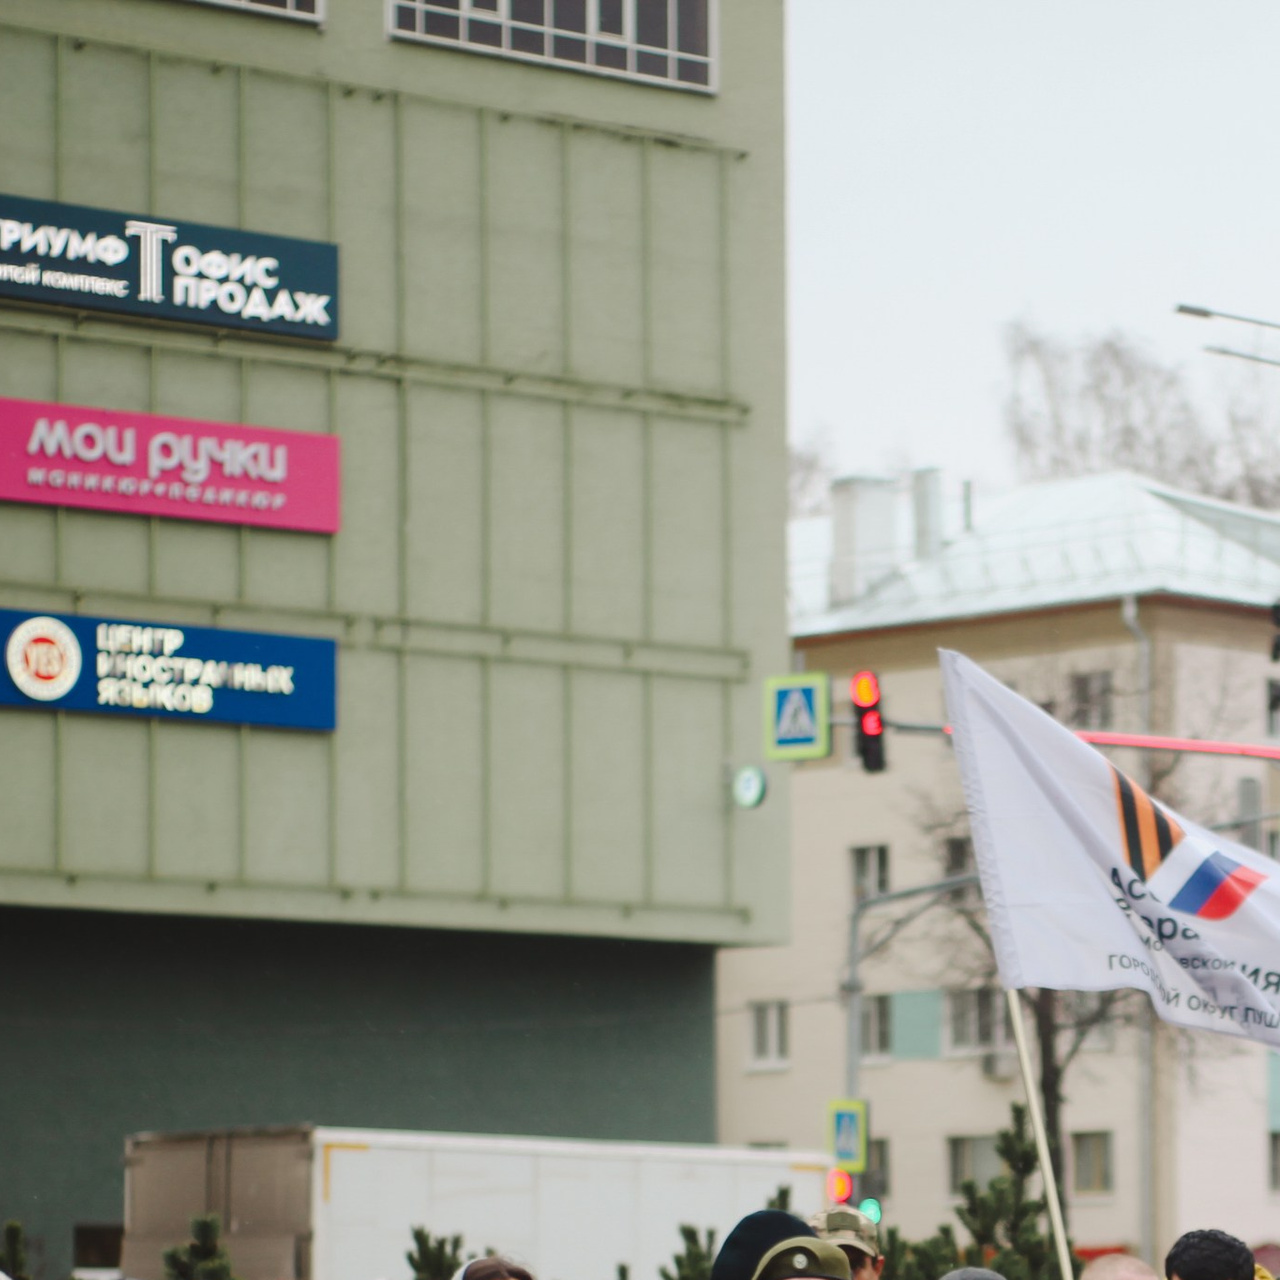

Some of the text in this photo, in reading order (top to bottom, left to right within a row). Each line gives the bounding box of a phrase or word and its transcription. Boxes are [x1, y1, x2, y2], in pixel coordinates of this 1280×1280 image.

[0, 219, 129, 266] РИУМФ
[172, 245, 280, 289] ОФИС
[173, 276, 331, 326] ПРОДАЖ
[96, 623, 184, 656] ЦЕНТР
[96, 650, 295, 695] ИНОСТРАННЫХ
[97, 677, 214, 714] ЯЗЫКОВ
